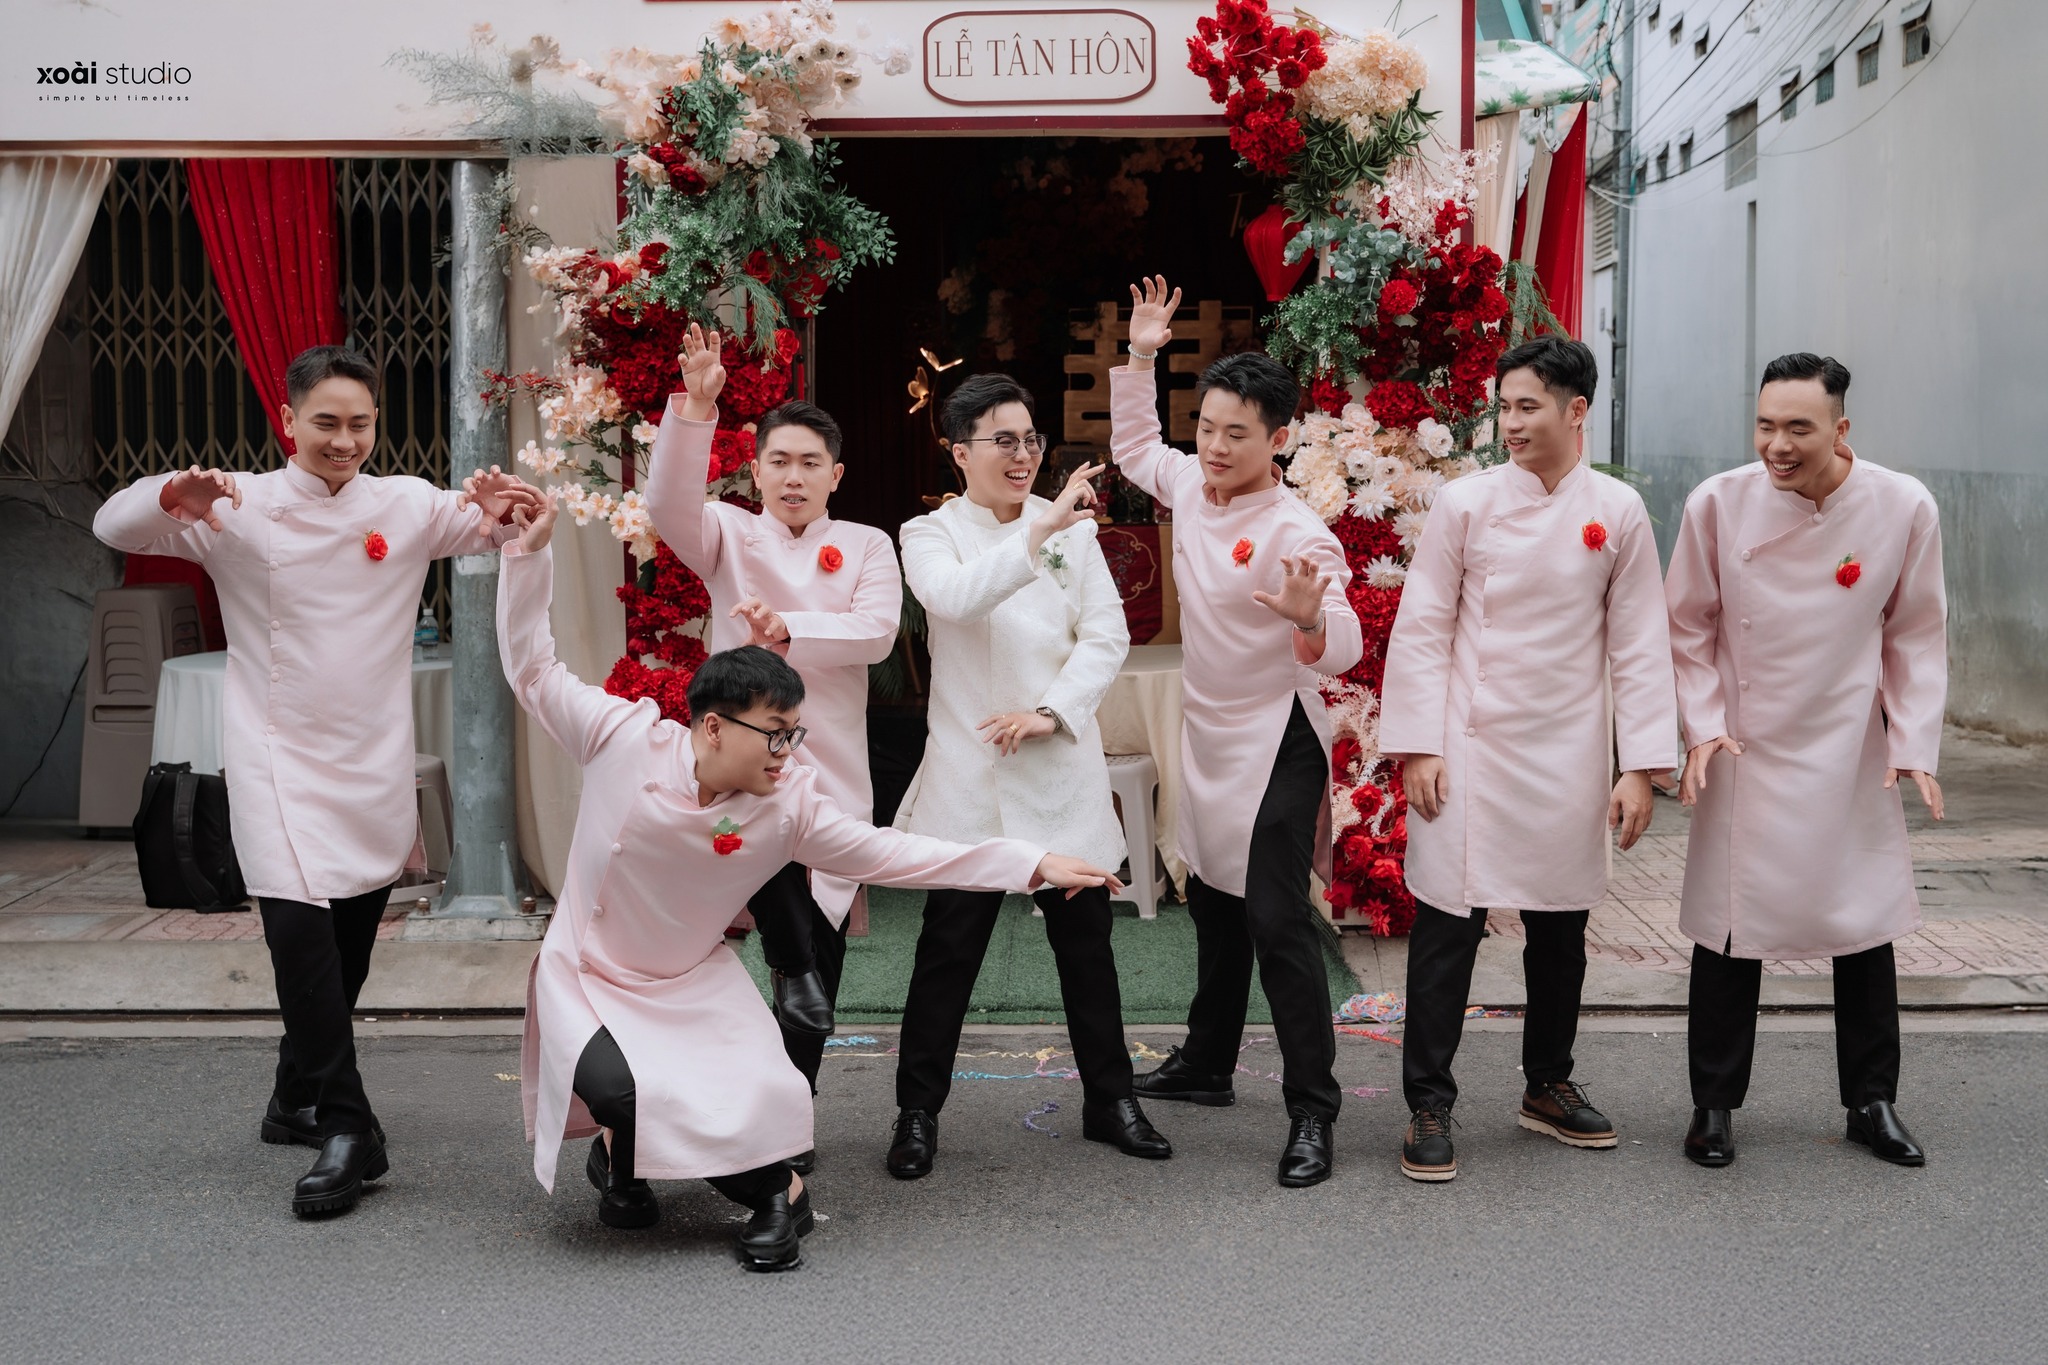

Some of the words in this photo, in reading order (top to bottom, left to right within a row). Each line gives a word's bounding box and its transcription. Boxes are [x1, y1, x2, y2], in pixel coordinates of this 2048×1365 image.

[934, 29, 973, 77] LỄ
[987, 33, 1055, 76] TÂN
[1070, 31, 1147, 75] HÔN
